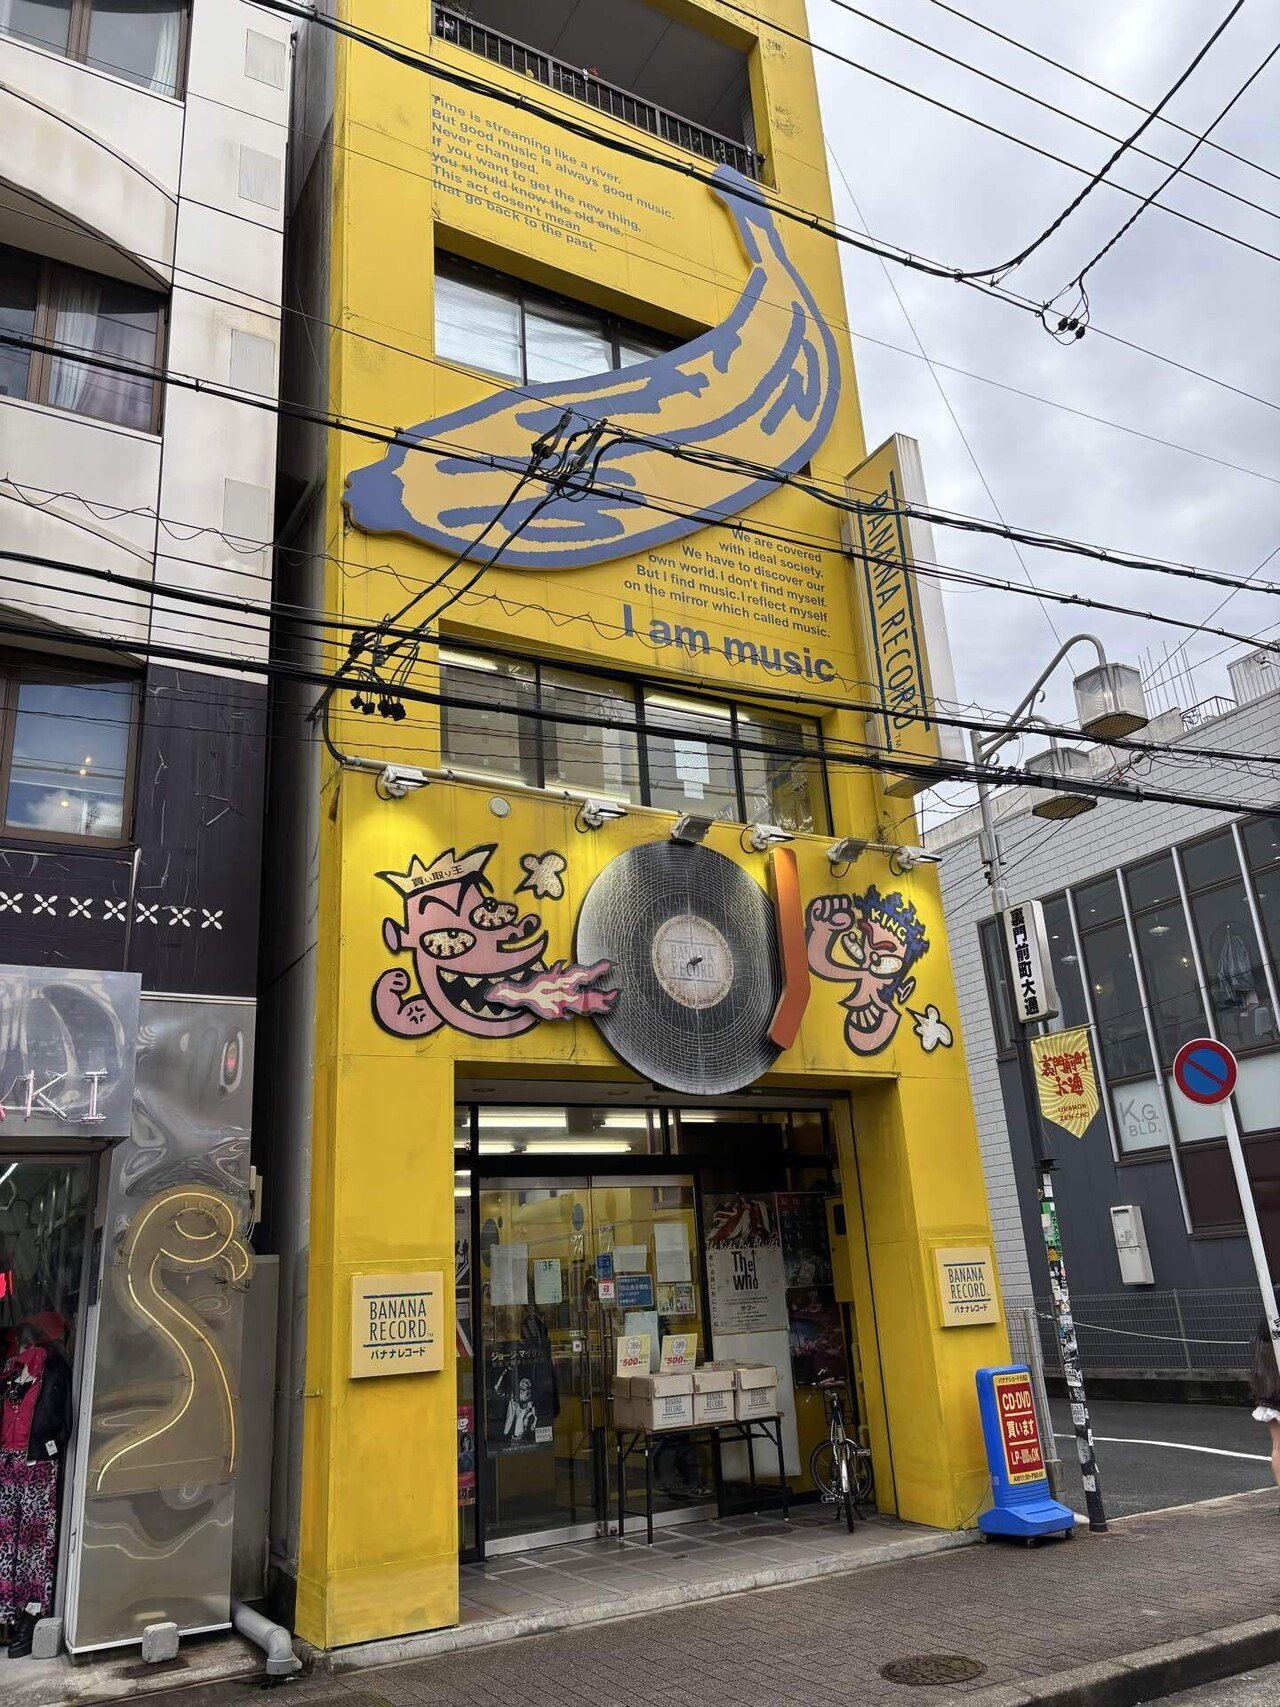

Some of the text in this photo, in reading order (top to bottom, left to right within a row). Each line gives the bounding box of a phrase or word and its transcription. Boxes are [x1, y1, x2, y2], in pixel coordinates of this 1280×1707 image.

[432, 94, 622, 184] Time is streaming like a river.
[432, 122, 539, 175] Never changed.
[432, 108, 676, 220] But good music is always good music.
[432, 136, 641, 232] If you want to get the new thing,
[432, 151, 625, 237] you should know the old one.
[432, 164, 580, 232] This act dosen't mean
[432, 180, 597, 252] that go back to the past.
[719, 541, 824, 578] with ideal society.
[732, 529, 822, 563] We are covered
[649, 554, 676, 568] own
[727, 574, 758, 590] don't
[761, 581, 783, 597] find
[787, 589, 828, 607] myself.
[682, 545, 826, 593] We have to discover our
[624, 579, 831, 638] on the mirror which called music.
[636, 564, 660, 580] But
[663, 571, 667, 581] I
[671, 573, 695, 589] find
[748, 595, 786, 612] reflect
[790, 605, 828, 623] myself
[866, 488, 919, 730] BANANA RECORD
[622, 604, 834, 683] I am music
[411, 864, 465, 888] 買い取り王
[871, 908, 907, 941] KING
[1009, 906, 1040, 1016] 裏門前町大通
[1058, 1103, 1087, 1113] URAMON
[1060, 1112, 1090, 1122] ZEN-CHO
[1119, 1099, 1159, 1125] K.G.
[1129, 1122, 1161, 1137] BLD.
[542, 1261, 553, 1271] 3F
[731, 1250, 755, 1275] The
[948, 1267, 984, 1283] BANANA
[733, 1273, 759, 1290] Who
[950, 1282, 986, 1299] RECORD
[370, 1299, 427, 1320] BANANA
[954, 1304, 988, 1314] バナナレコード
[370, 1319, 427, 1341] RECORD
[370, 1346, 426, 1360] バナナレコード
[1006, 1419, 1034, 1438] 買います
